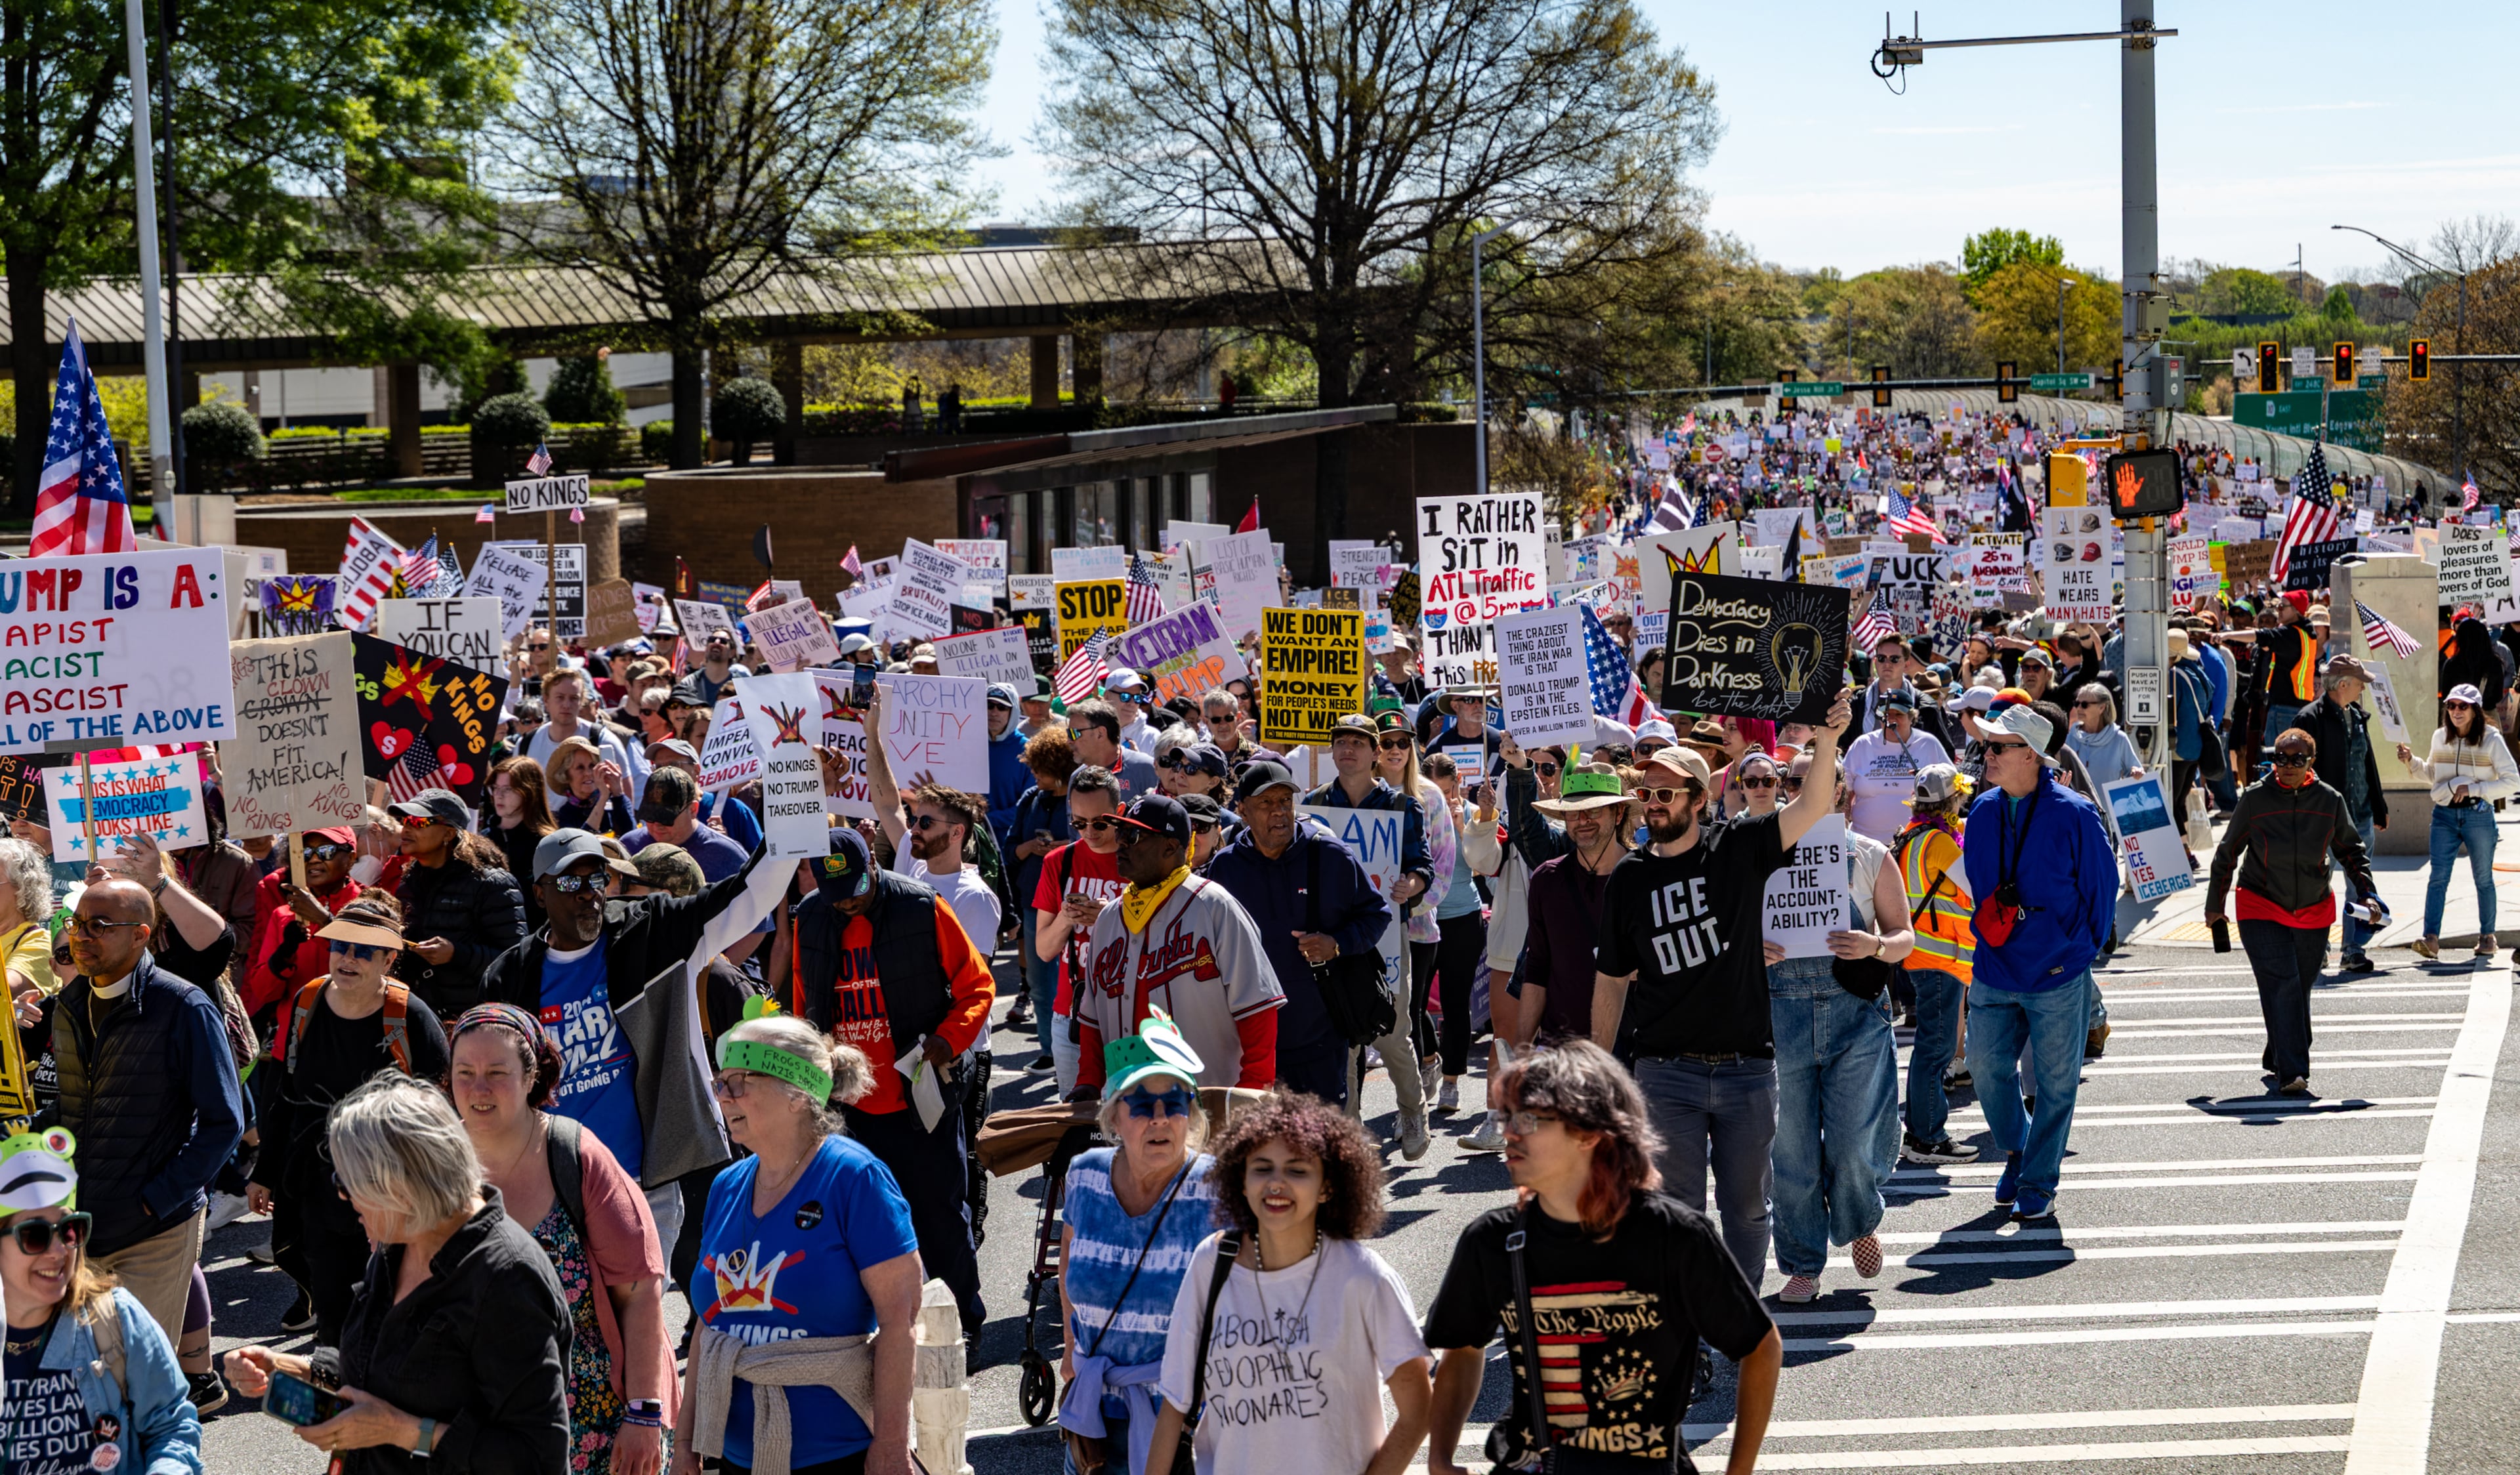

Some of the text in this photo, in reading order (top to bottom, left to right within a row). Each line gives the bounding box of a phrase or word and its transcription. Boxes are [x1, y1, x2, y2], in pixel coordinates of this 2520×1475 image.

[2032, 378, 2056, 386] Capitol
[2059, 377, 2067, 386] Sq
[509, 477, 589, 507] NO KINGS
[1421, 499, 1536, 537] I RATHER
[1972, 534, 2023, 546] ACTIVATE
[2452, 527, 2482, 541] DOES
[519, 550, 570, 559] NO LOGER
[1341, 551, 1387, 564] STRENGTH
[1497, 537, 1519, 566] in
[2198, 551, 2209, 561] IS
[2299, 541, 2349, 556] history
[2443, 540, 2494, 556] lovers of
[481, 549, 534, 582] RELEASE
[565, 560, 575, 569] IN
[912, 557, 954, 579] SECURITY?
[913, 549, 956, 573] HOMELAND
[1971, 565, 2024, 577] AMENDMENT
[2288, 557, 2327, 571] has its
[2441, 553, 2499, 571] pleasures
[1011, 578, 1054, 587] OBEDIEN
[1158, 571, 1169, 580] ITS
[1343, 571, 1381, 586] PEACE
[2063, 571, 2093, 584] HATE
[2292, 576, 2309, 587] on
[2439, 566, 2502, 581] more than
[0, 568, 83, 615] UMP
[104, 566, 140, 610] IS
[910, 575, 946, 595] HOMELAND
[1427, 571, 1469, 602] ATL
[1469, 568, 1536, 597] Traffic
[2438, 575, 2510, 594] overs of God
[900, 585, 949, 615] BRUTALITY
[1032, 596, 1051, 605] NOT
[1060, 584, 1122, 620] STOP
[1323, 600, 1358, 610] BELONGS
[1327, 590, 1350, 600] ICE
[2059, 589, 2099, 602] WEARS
[417, 601, 463, 631] IF
[1933, 598, 1969, 621] CLEAN
[2046, 606, 2110, 620] MANY HATS
[1266, 612, 1297, 634] WE
[1303, 614, 1359, 636] DON'T
[1642, 614, 1664, 627] OUT
[5, 617, 114, 646] APIST
[763, 621, 822, 647] ILLEGAL ON
[1061, 628, 1090, 637] THE
[1118, 604, 1220, 669] VETERAN
[1427, 626, 1482, 657] THAN
[1506, 623, 1568, 642] THE CRAZIEST
[1674, 621, 1755, 654] Dies in
[398, 629, 490, 657] YOU CAN
[1267, 636, 1358, 648] WANT AN
[1508, 636, 1566, 654] THING ABOUT
[1933, 634, 1961, 657] 47
[0, 651, 104, 680] ACIST
[956, 651, 1018, 673] ILLEGAL ON
[1267, 647, 1358, 675] EMPIRE!
[1508, 647, 1572, 666] THE IRAN WAR
[1431, 665, 1466, 686] this
[1524, 661, 1558, 676] IS THAT
[266, 671, 330, 697] CLOWN
[469, 673, 496, 712] NO
[1267, 680, 1358, 697] MONEY
[1507, 676, 1580, 697] DONALD TRUMP
[5, 684, 129, 715] ASCIST
[1267, 696, 1357, 710] FOR PEOPLE'S NEEDS
[1524, 691, 1566, 707] IS IN THE
[1692, 690, 1793, 720] be the light
[444, 676, 486, 755] KINGS
[1511, 706, 1550, 722] EPSTEIN
[1553, 702, 1583, 716] FILES.
[28, 720, 54, 742] OF
[66, 714, 123, 739] THE
[132, 705, 224, 735] ABOVE
[258, 714, 329, 743] DOESN'T
[1511, 727, 1530, 738] (OVER
[1538, 722, 1564, 733] MILLION
[1564, 719, 1587, 730] TIMES)
[698, 759, 759, 788] REMOVE
[768, 759, 818, 774] NO KINGS.
[329, 783, 350, 800] NO
[768, 780, 819, 795] NO TRUMP
[79, 793, 169, 819] DEMOCRACY
[232, 796, 257, 814] NO
[767, 802, 823, 817] TAKEOVER.
[136, 812, 174, 833] LIKE
[2124, 836, 2139, 853] NO
[2128, 852, 2147, 869] ICE
[1787, 869, 1819, 889] THE
[2132, 865, 2155, 884] YES
[2137, 873, 2191, 900] ICEBERGS
[1650, 876, 1709, 928] ICE
[1766, 889, 1843, 910] ACCOUNT-
[1771, 907, 1839, 930] ABILITY?
[763, 1049, 824, 1085] FROGS RULE
[576, 1071, 611, 1093] GOING
[1534, 1304, 1663, 1337] The People
[12, 1373, 75, 1398] TYRAN
